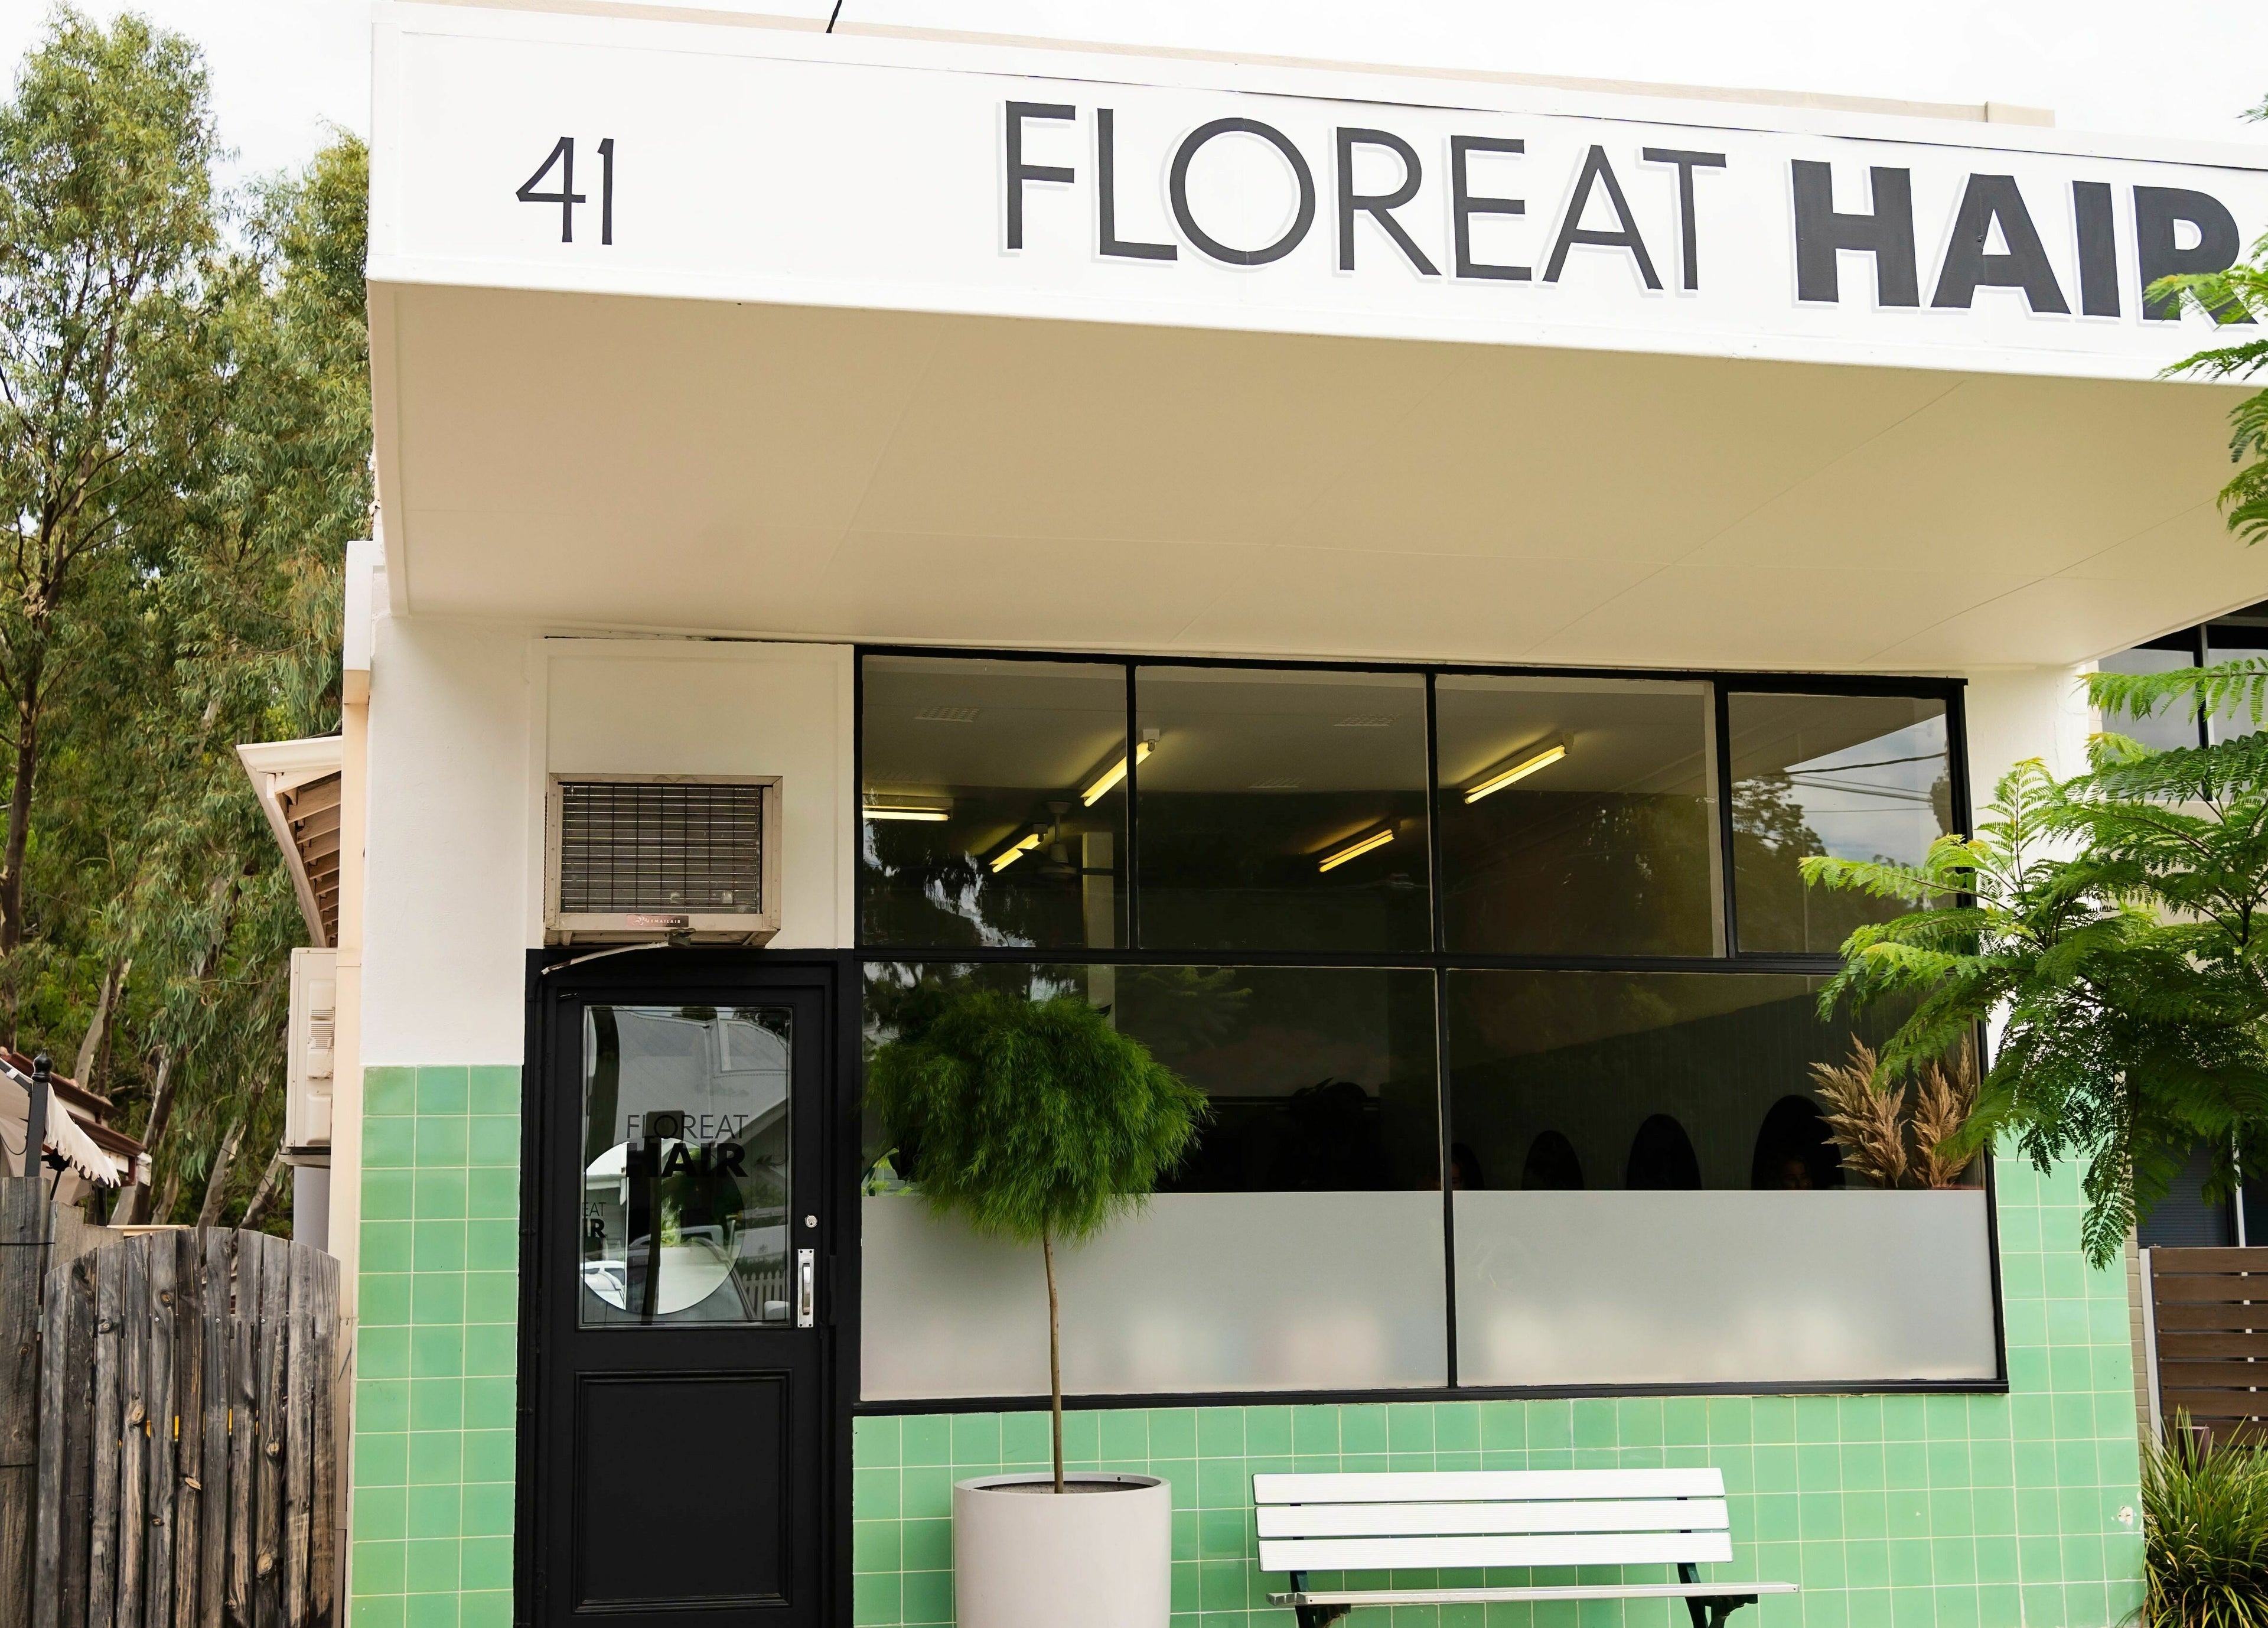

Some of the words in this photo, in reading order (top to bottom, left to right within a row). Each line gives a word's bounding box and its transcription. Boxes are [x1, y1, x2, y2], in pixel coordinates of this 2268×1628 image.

[516, 136, 614, 245] 41
[1005, 100, 1727, 290] FLOREAT
[1790, 159, 2259, 324] HAIR
[626, 1142, 748, 1177] HAIR
[627, 1114, 748, 1139] FLOREAT
